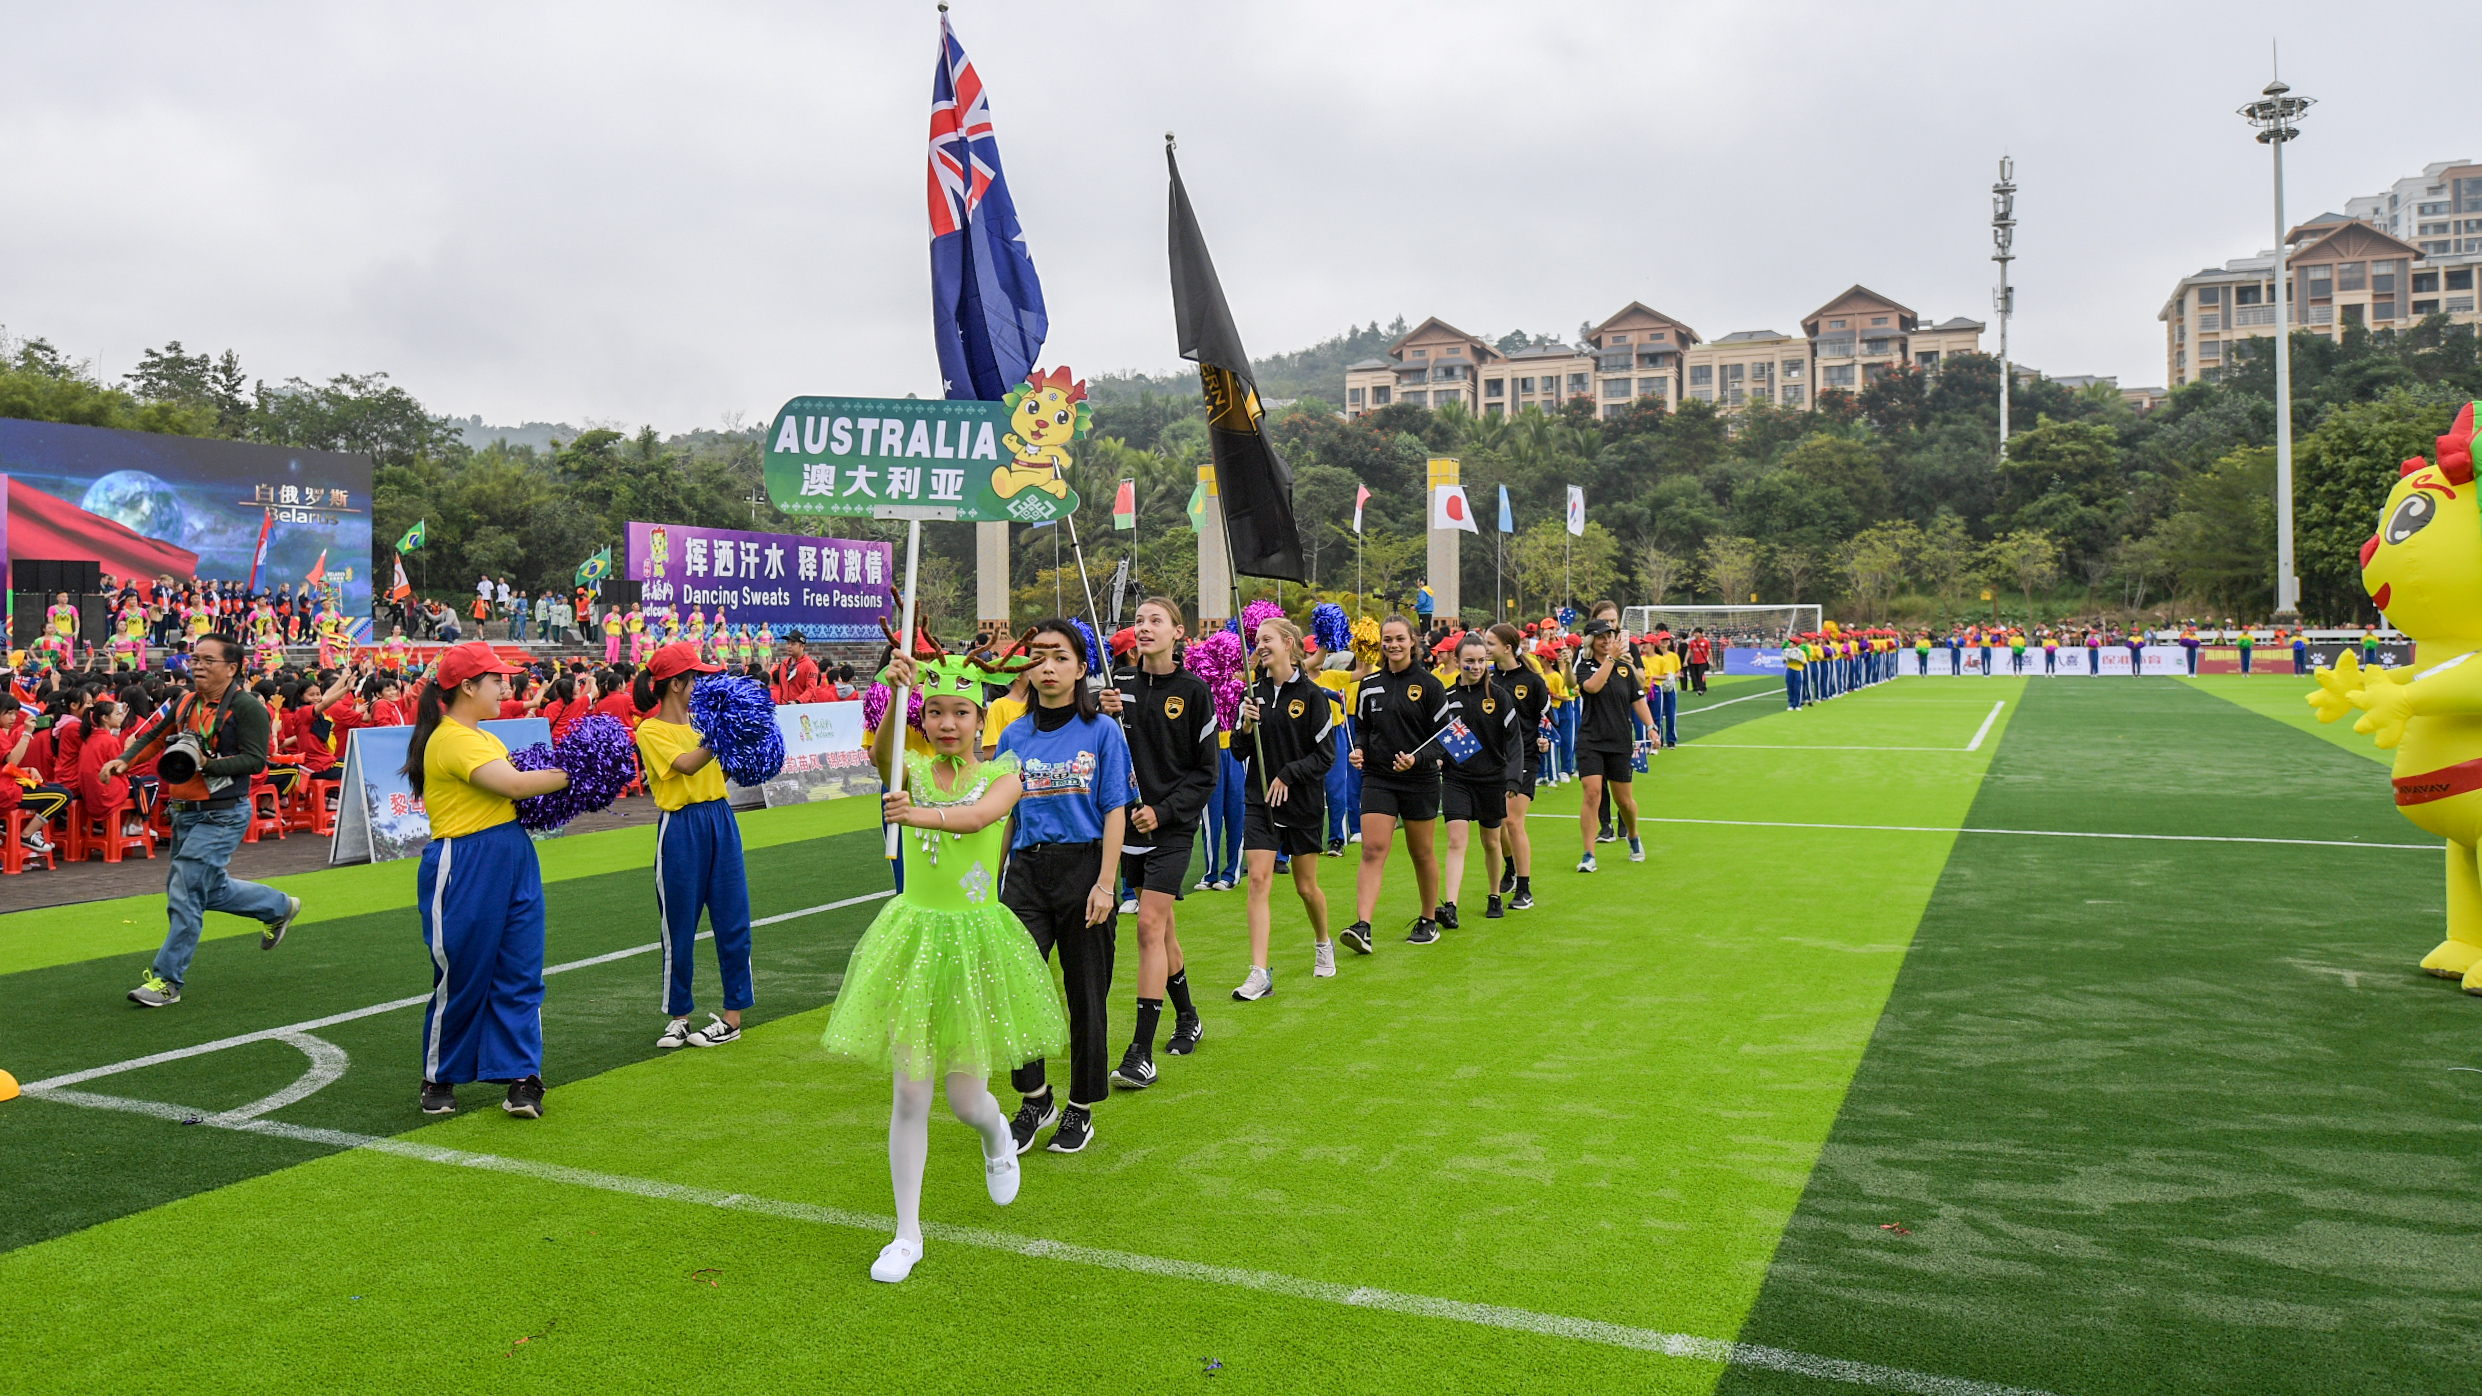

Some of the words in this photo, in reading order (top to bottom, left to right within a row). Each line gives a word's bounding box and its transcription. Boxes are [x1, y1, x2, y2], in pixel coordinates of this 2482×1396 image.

[774, 415, 998, 460] AUSTRALIA
[255, 484, 349, 508] 白俄罗斯
[800, 463, 965, 500] 澳大利亚
[685, 536, 785, 580] 挥洒汗水
[798, 545, 883, 585] 释放激情
[643, 602, 670, 617] welcom
[683, 584, 739, 610] Dancing
[742, 585, 790, 606] Sweats
[803, 588, 830, 608] Free
[833, 589, 883, 609] Passions
